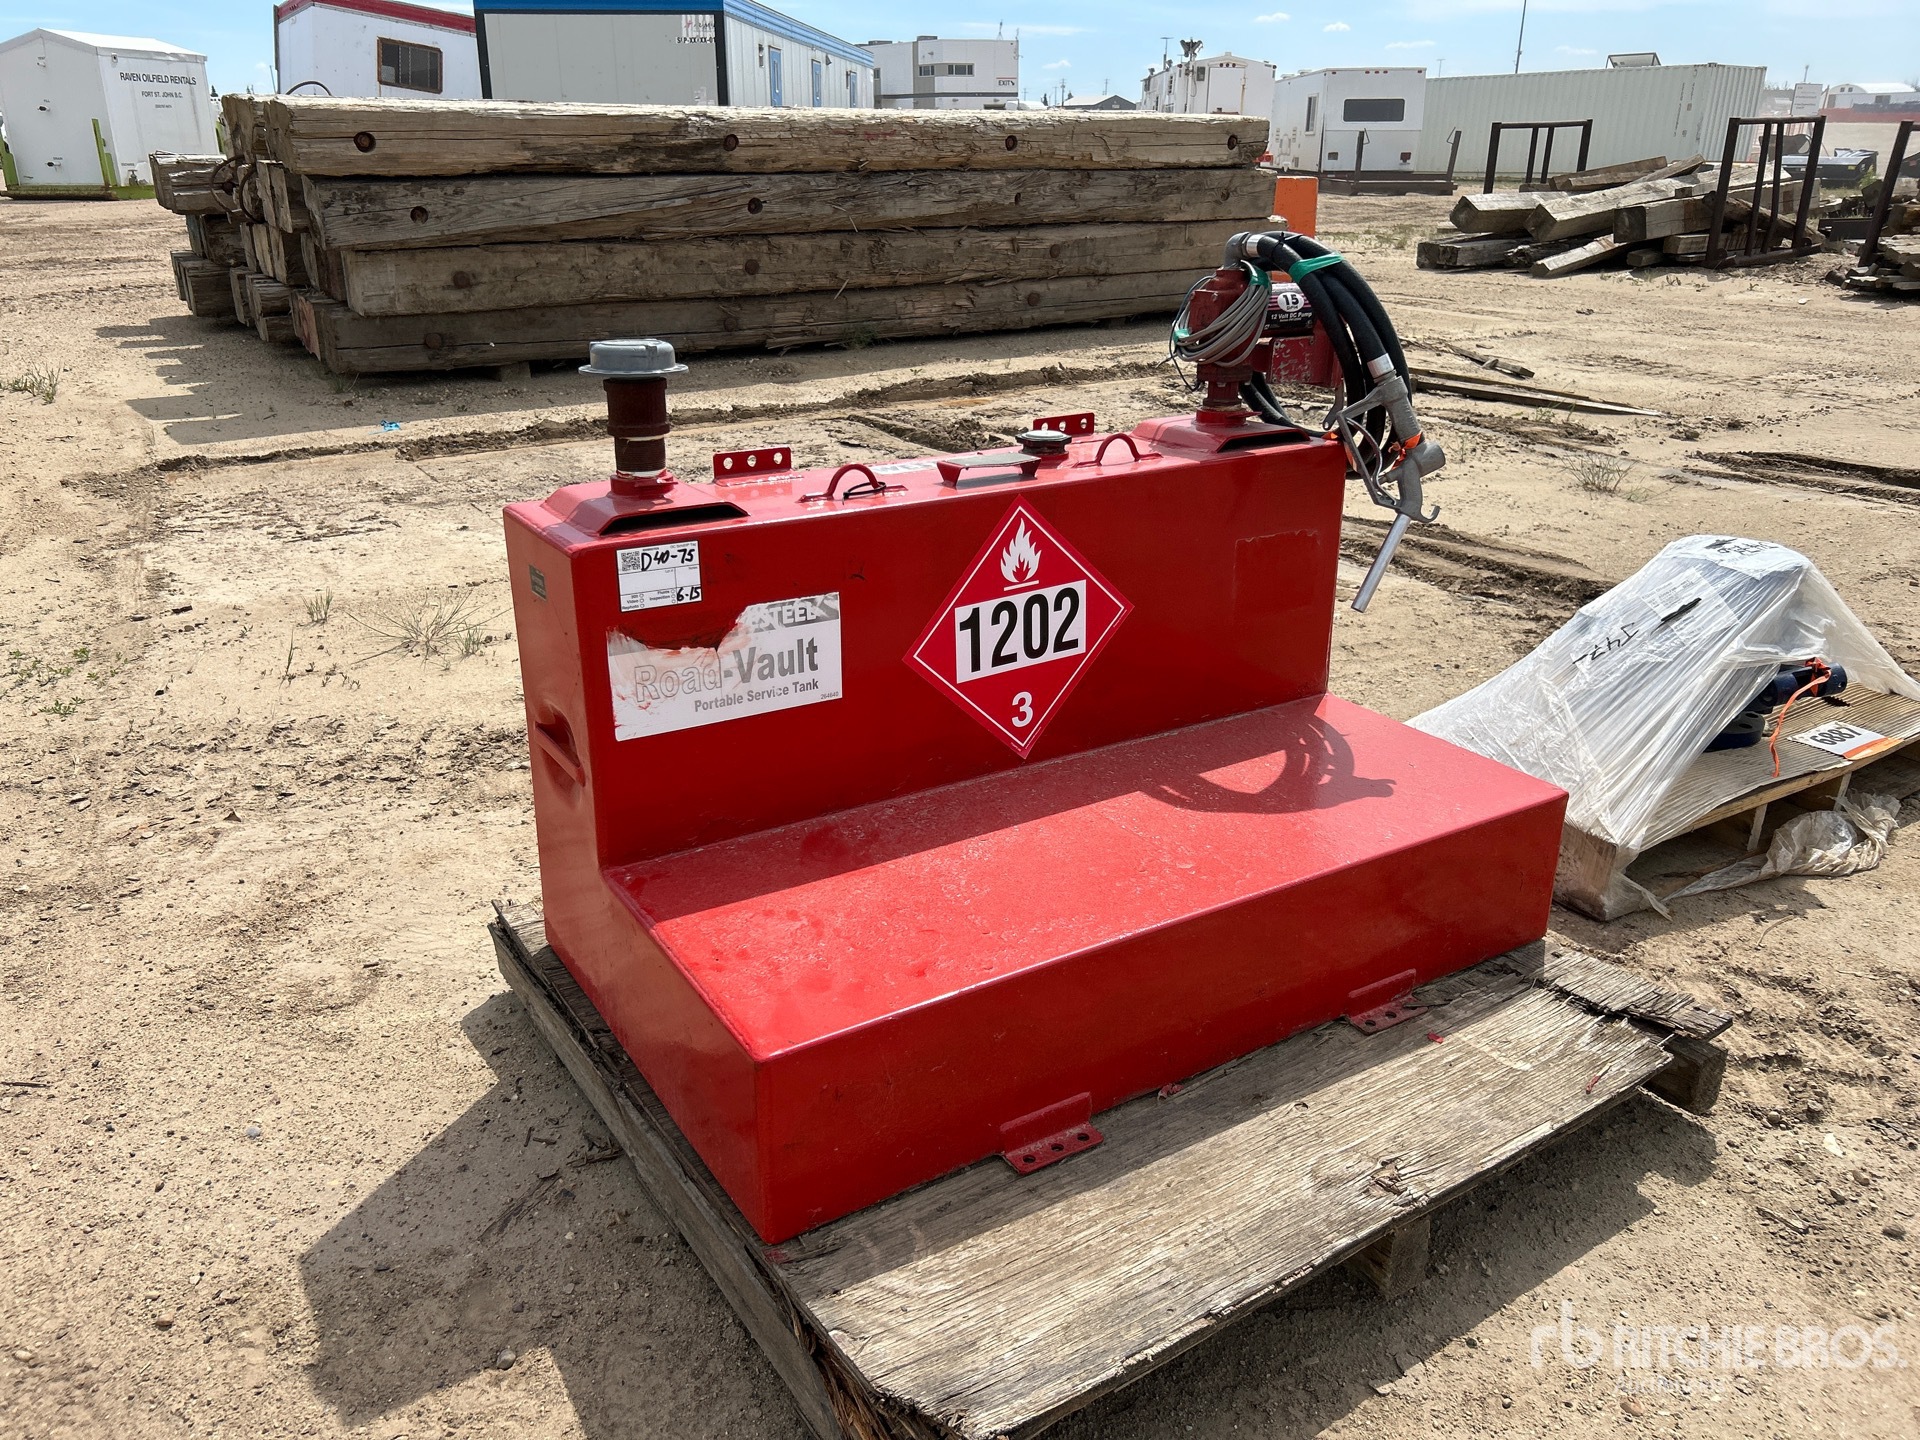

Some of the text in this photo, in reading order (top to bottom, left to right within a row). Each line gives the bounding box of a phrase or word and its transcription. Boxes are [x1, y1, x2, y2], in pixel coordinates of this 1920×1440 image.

[120, 72, 197, 86] RAVEN OILFIELD RENTALS
[1283, 294, 1299, 306] 15
[1298, 311, 1312, 319] Pump
[677, 586, 701, 602] 6-15
[959, 587, 1080, 673] 1202
[634, 637, 819, 703] Road-Vault
[695, 678, 819, 713] Portable Service Tank
[1011, 691, 1034, 728] 3
[1810, 726, 1862, 746] 6887
